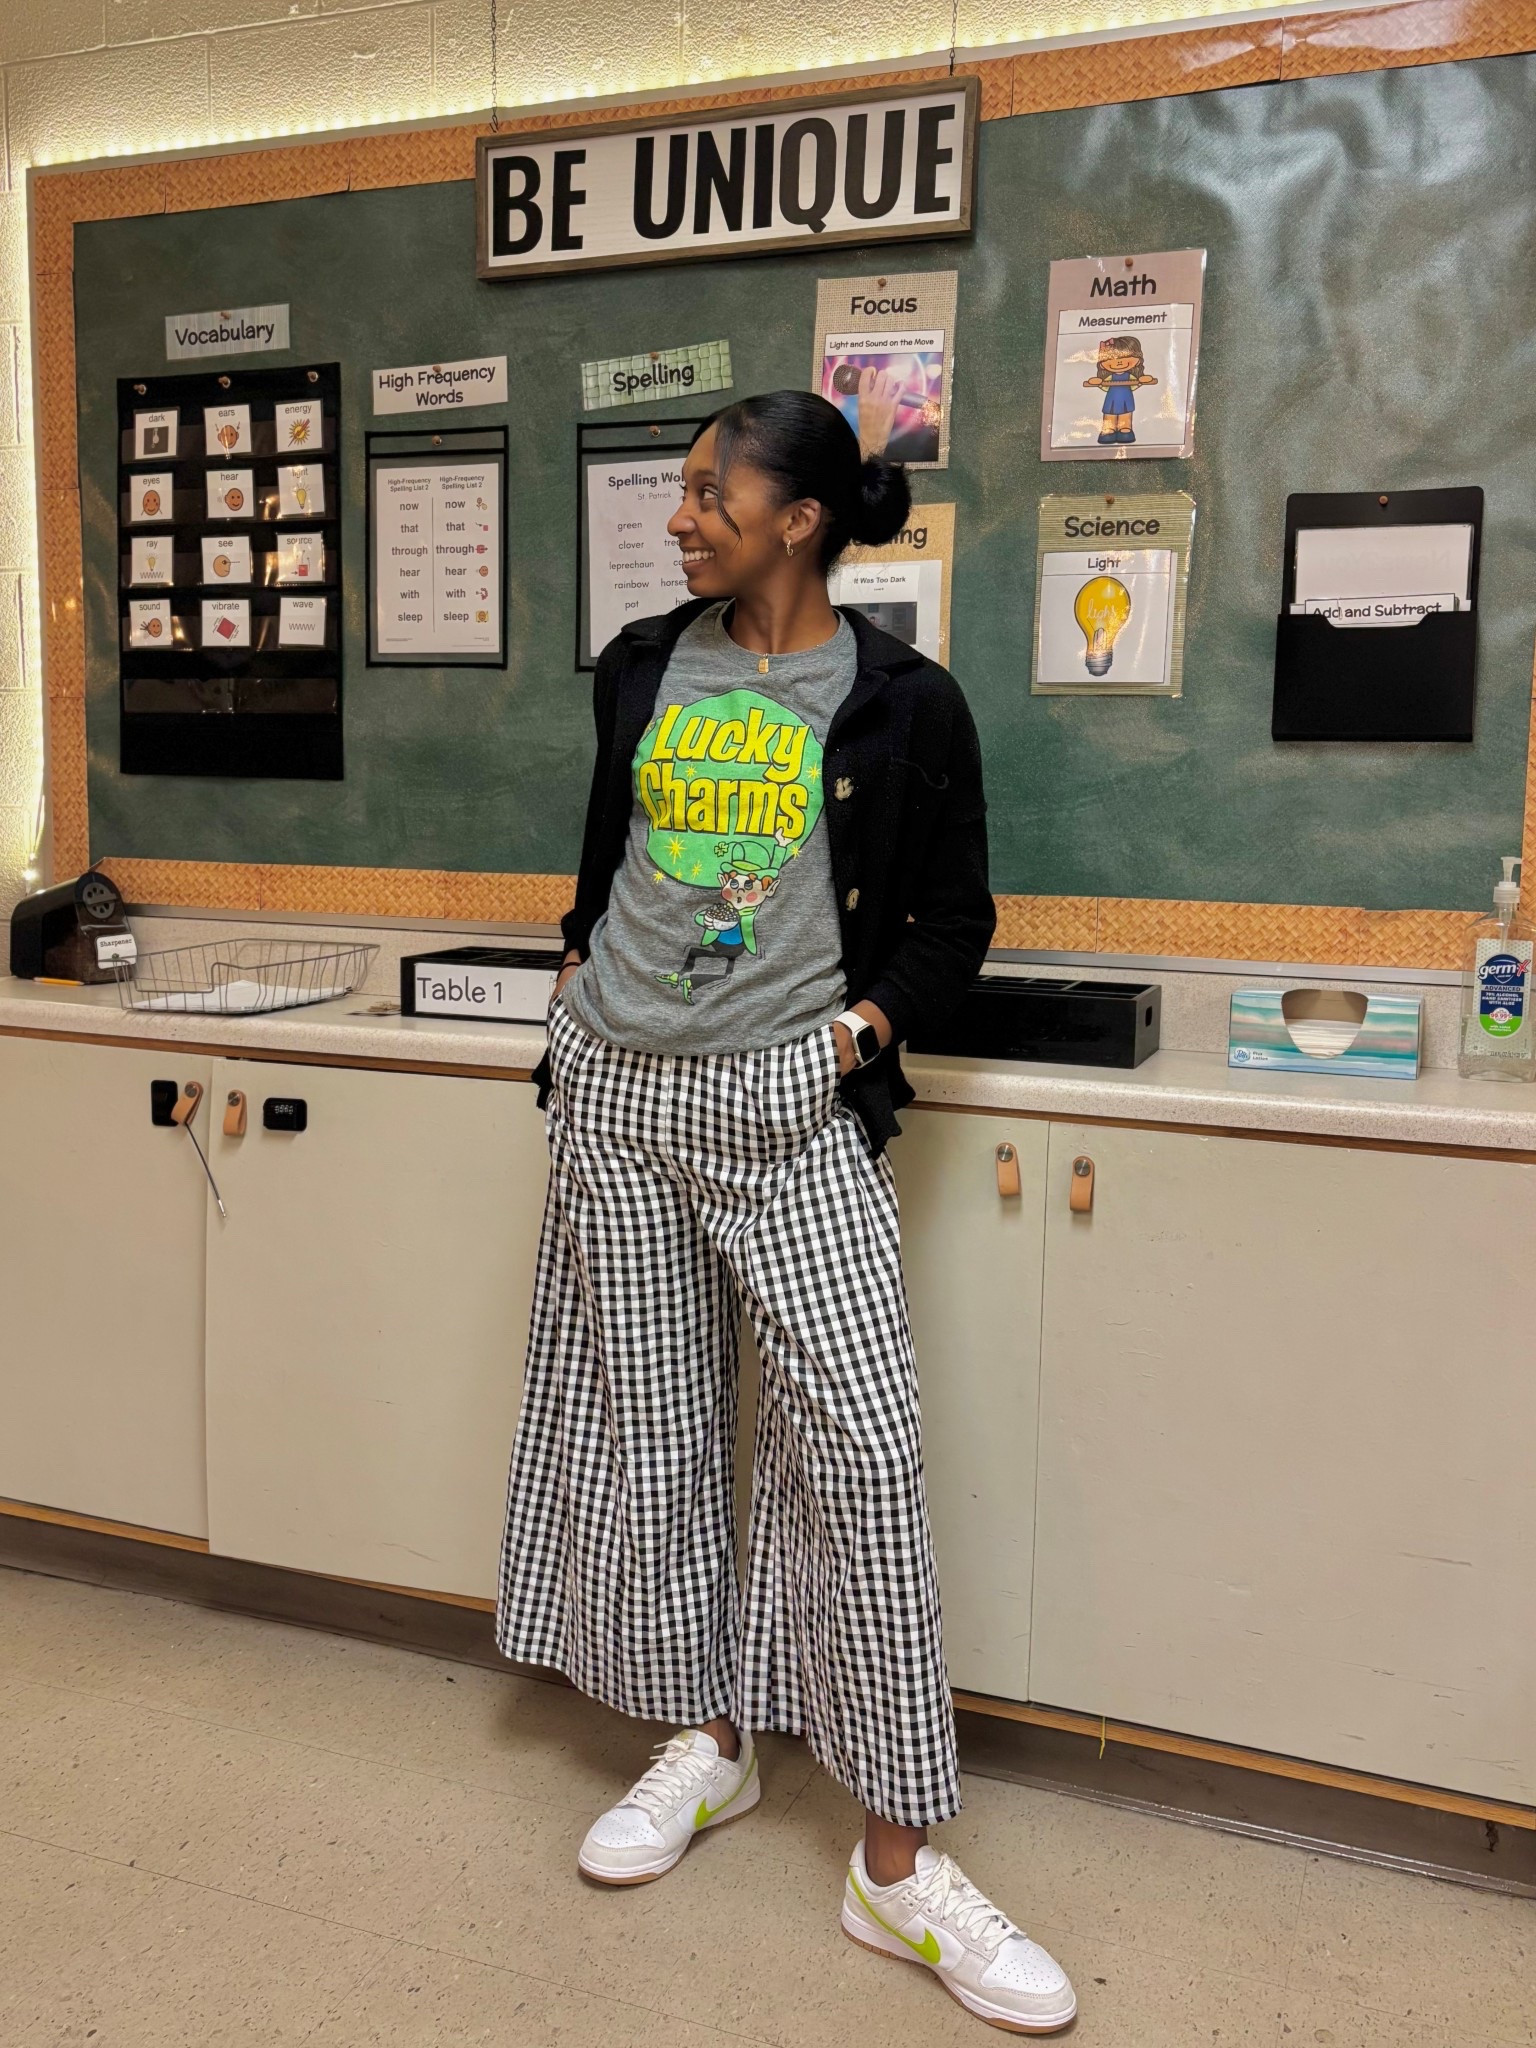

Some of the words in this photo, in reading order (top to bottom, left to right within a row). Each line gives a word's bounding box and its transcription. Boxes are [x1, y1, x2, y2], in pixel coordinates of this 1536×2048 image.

[493, 149, 587, 257] BE
[633, 104, 956, 240] UNIQUE
[1090, 274, 1157, 298] Math
[851, 296, 918, 315] Focus
[1078, 312, 1167, 327] Measurement
[175, 320, 274, 346] Vocabulary
[830, 341, 849, 350] Light
[914, 338, 934, 346] Move
[379, 373, 414, 392] High
[418, 366, 496, 387] Frequency
[613, 364, 695, 396] Spelling
[416, 389, 464, 406] Words
[218, 409, 235, 417] ears
[285, 404, 312, 414] energy
[148, 414, 166, 422] dark
[142, 476, 160, 486] eyes
[220, 473, 239, 481] hear
[608, 473, 657, 490] Spelling
[442, 482, 464, 490] Spelling
[649, 490, 671, 500] Patrick
[400, 503, 419, 511] now
[445, 501, 466, 509] now
[400, 524, 419, 533] that
[446, 522, 466, 531] that
[618, 522, 642, 532] green
[1064, 516, 1160, 538] Science
[146, 540, 158, 550] ray
[218, 539, 233, 547] see
[618, 540, 644, 550] clover
[392, 546, 428, 557] through
[436, 544, 474, 555] through
[609, 560, 654, 572] leprechaun
[1088, 557, 1121, 571] Light
[400, 568, 421, 577] hear
[445, 566, 467, 576] hear
[614, 579, 650, 589] rainbow
[400, 590, 420, 599] with
[446, 588, 466, 598] with
[139, 602, 161, 611] sound
[212, 602, 240, 610] vibrate
[625, 601, 639, 611] pot
[1344, 605, 1371, 618] and
[1375, 602, 1442, 617] Subtract
[398, 612, 423, 623] sleep
[443, 611, 469, 623] sleep
[650, 704, 811, 784] Lucky
[639, 760, 808, 839] Charms
[100, 939, 132, 947] Sharpener
[416, 976, 486, 1004] Table
[493, 982, 502, 1004] 1
